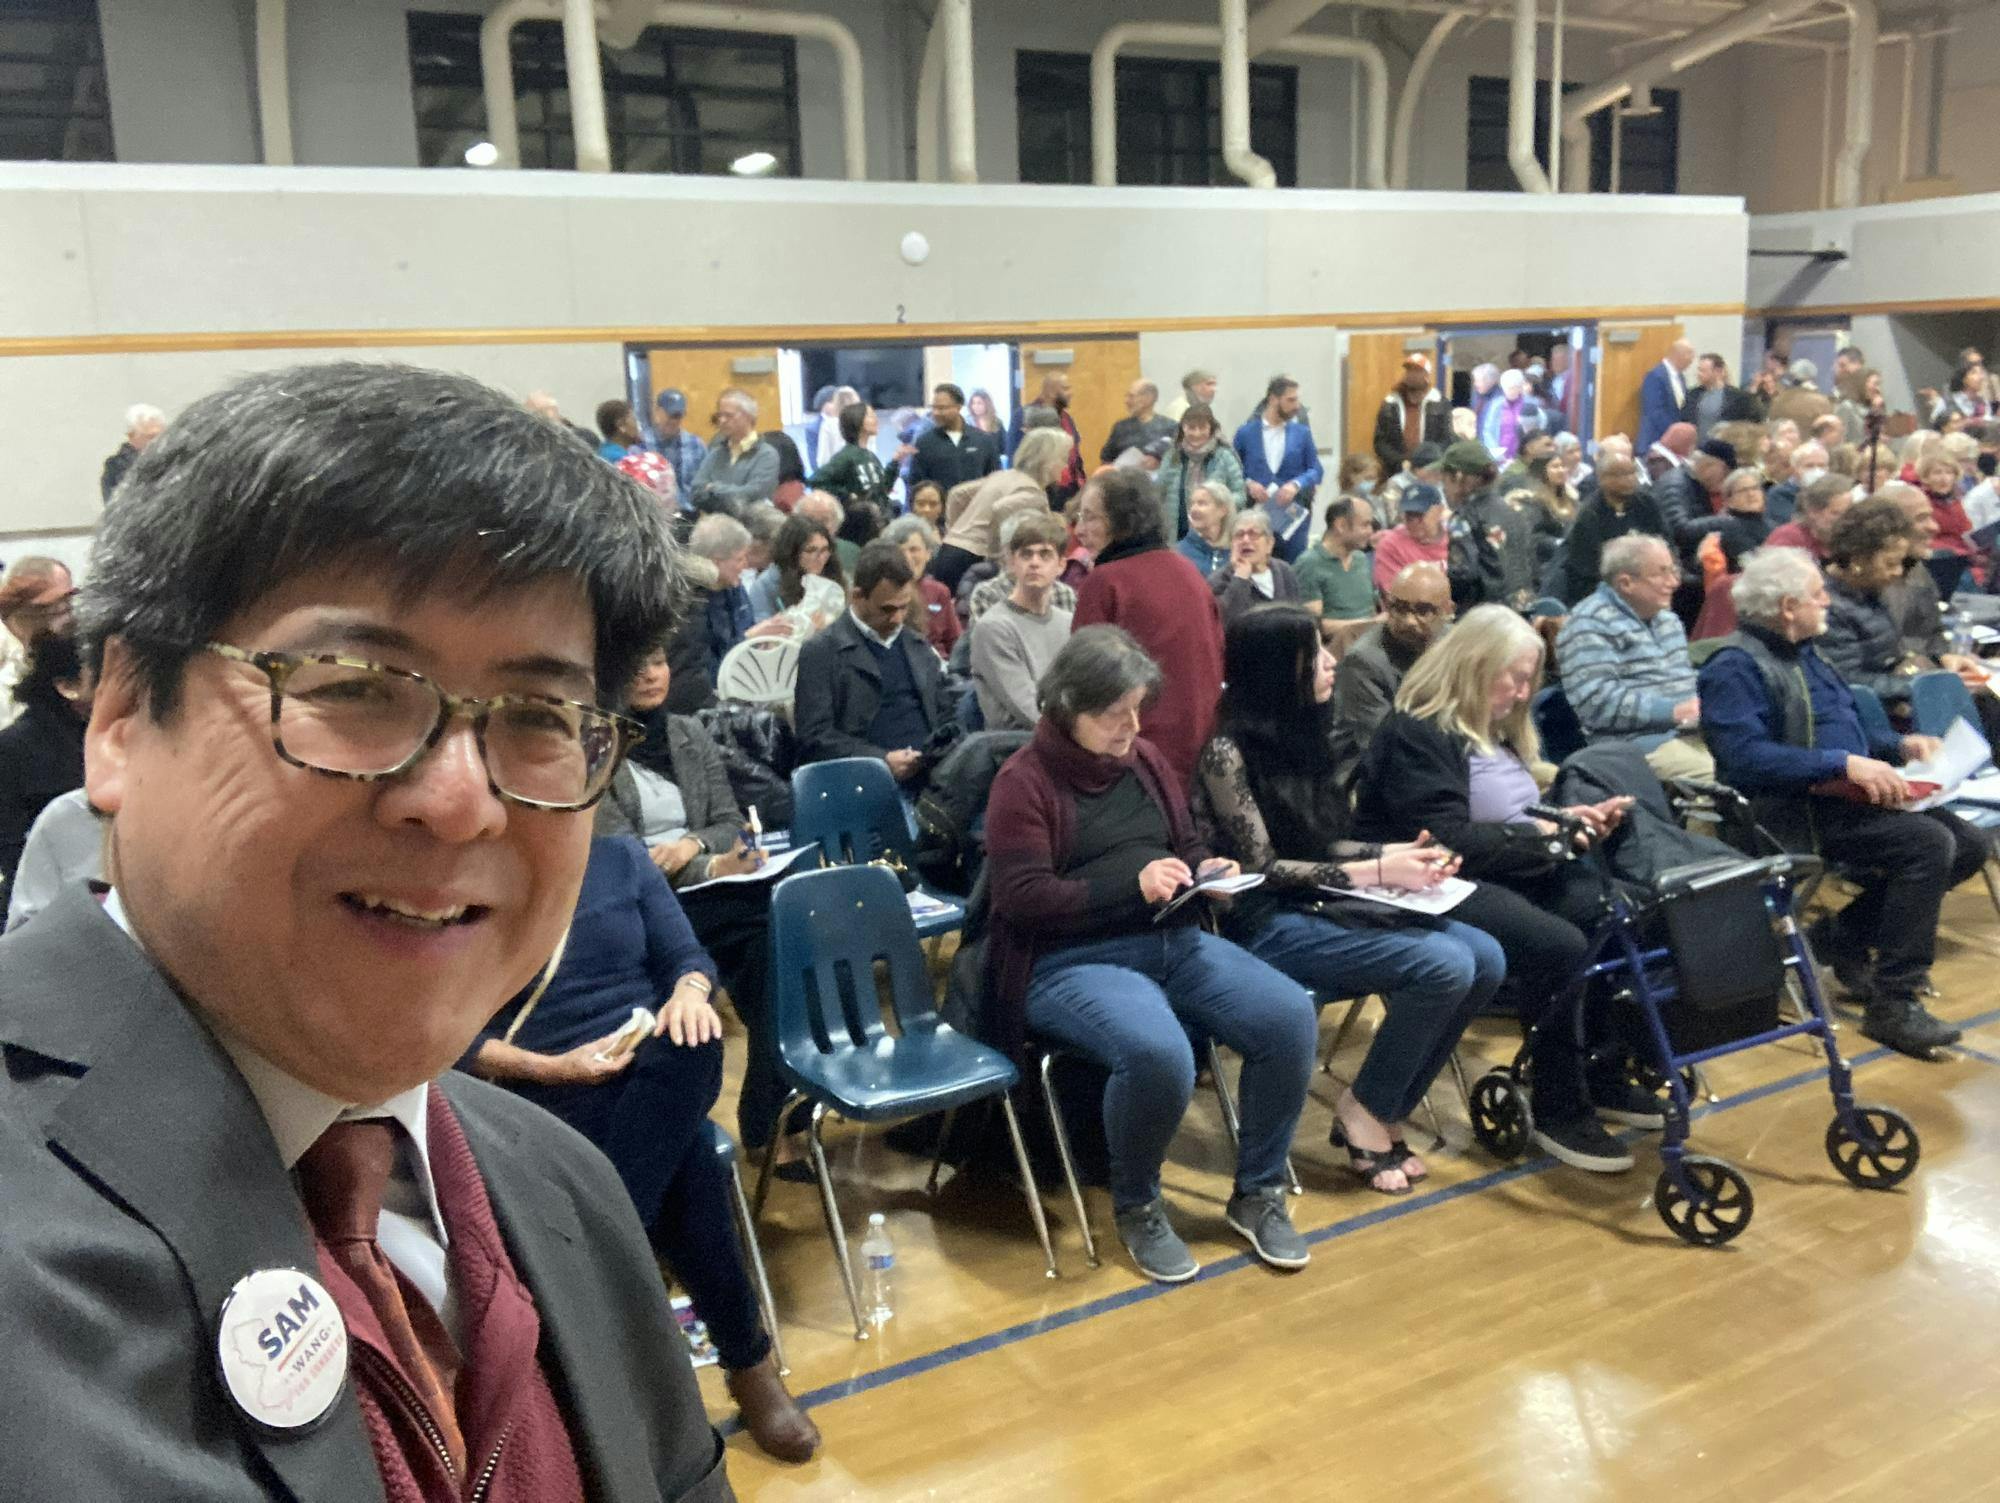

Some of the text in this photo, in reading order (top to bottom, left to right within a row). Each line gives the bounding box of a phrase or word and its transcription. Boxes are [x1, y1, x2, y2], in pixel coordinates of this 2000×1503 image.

[896, 304, 906, 323] 2
[258, 1284, 320, 1360] SAM
[292, 1328, 329, 1373] WANG
